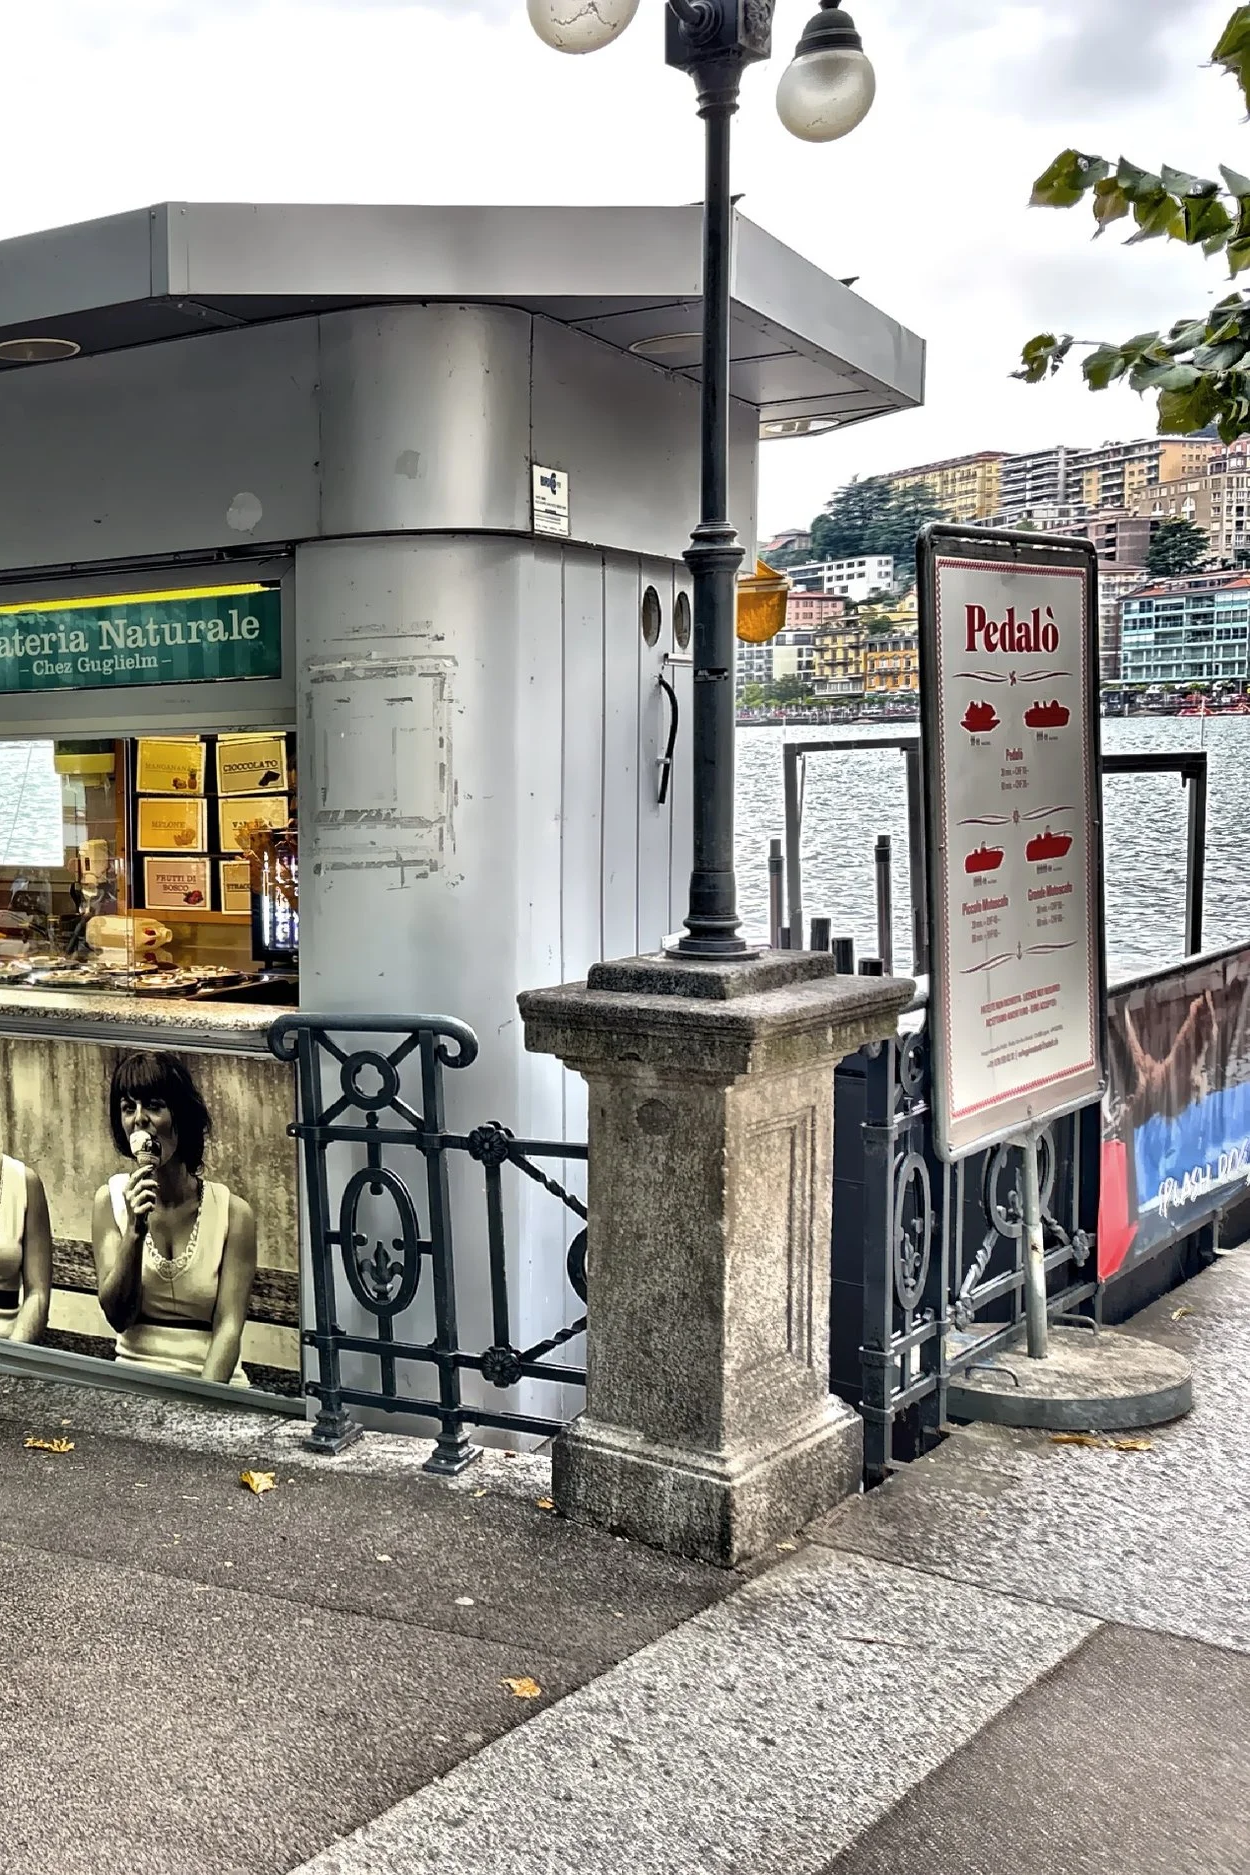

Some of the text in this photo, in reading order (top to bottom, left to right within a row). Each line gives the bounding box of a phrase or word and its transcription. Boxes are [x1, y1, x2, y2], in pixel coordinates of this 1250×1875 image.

[98, 609, 260, 651] Naturale
[965, 604, 1059, 653] Pedalò
[33, 653, 158, 676] Chez Guglielm
[223, 759, 278, 772] CIOCCOLATO
[152, 820, 186, 828] MELONE
[156, 875, 184, 883] FRUTTI
